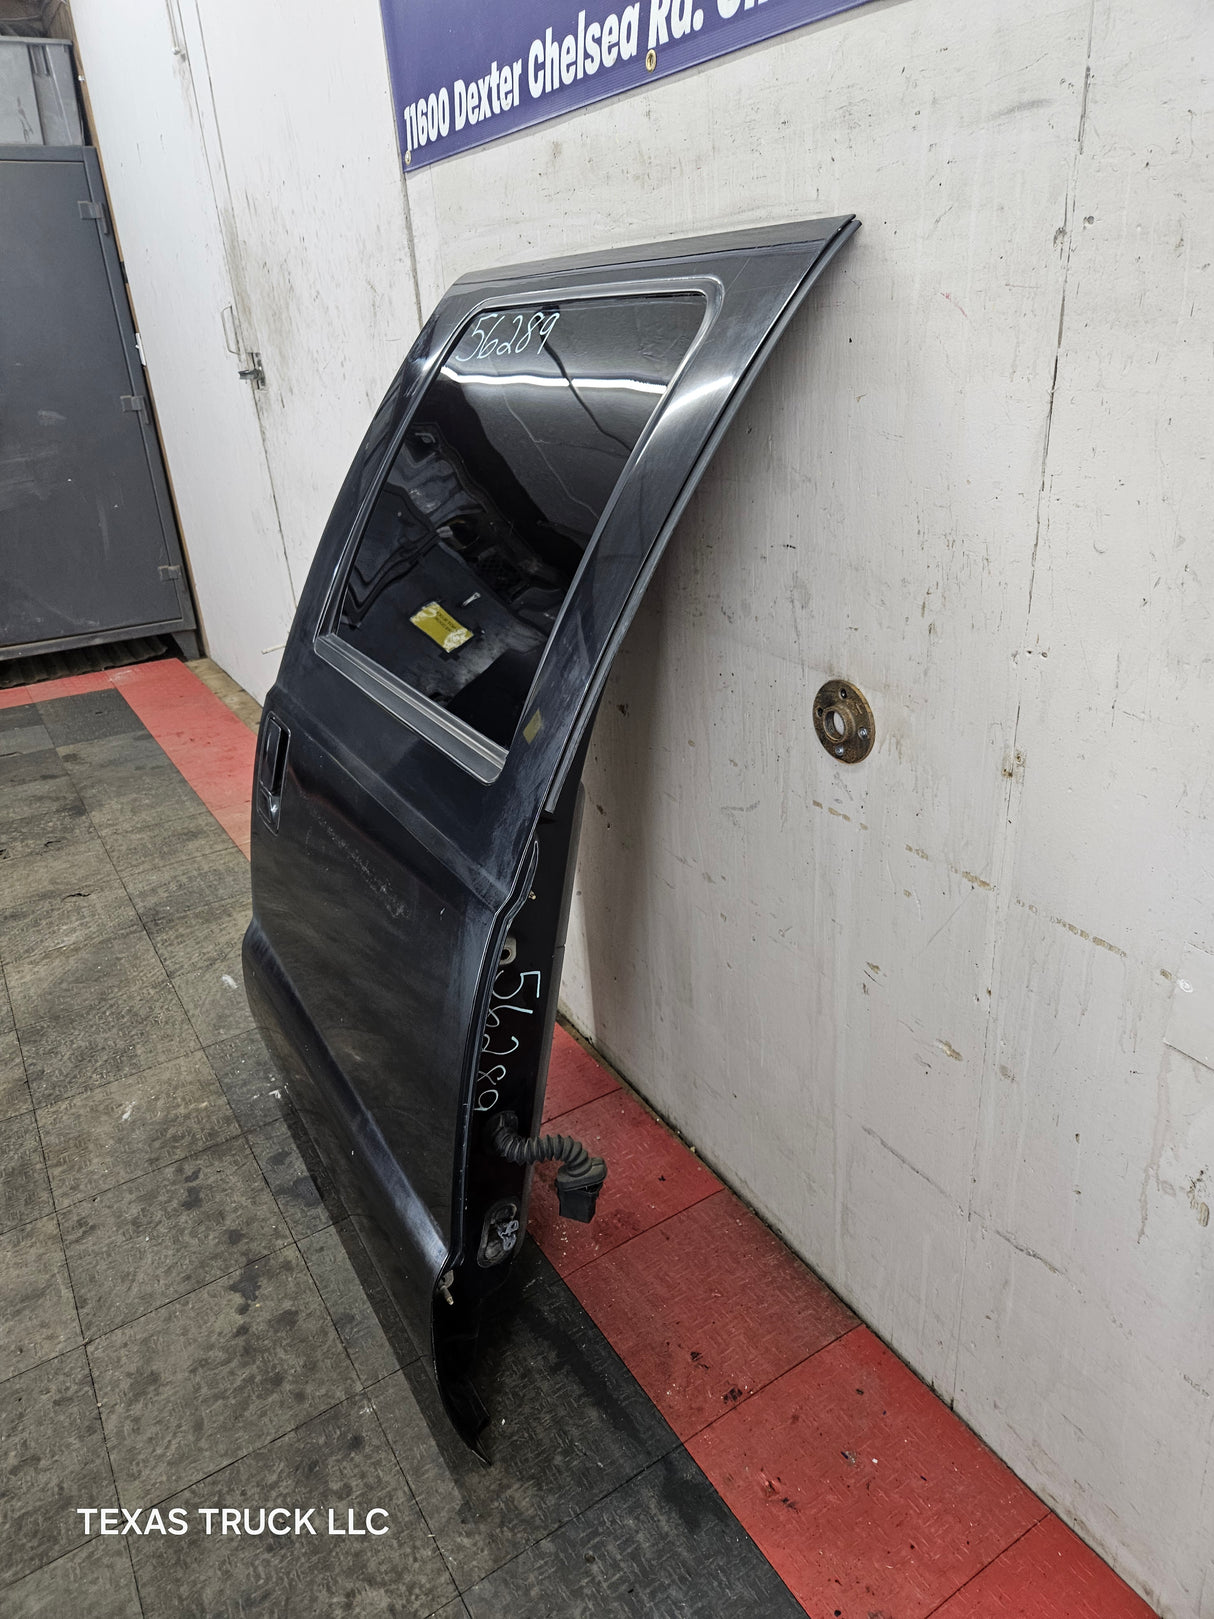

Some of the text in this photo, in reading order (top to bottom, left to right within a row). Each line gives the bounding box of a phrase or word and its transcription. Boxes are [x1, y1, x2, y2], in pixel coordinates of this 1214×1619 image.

[404, 87, 450, 151] 11600
[454, 58, 522, 131] Dexter
[528, 2, 640, 98] Chelsea
[455, 311, 561, 362] 56289
